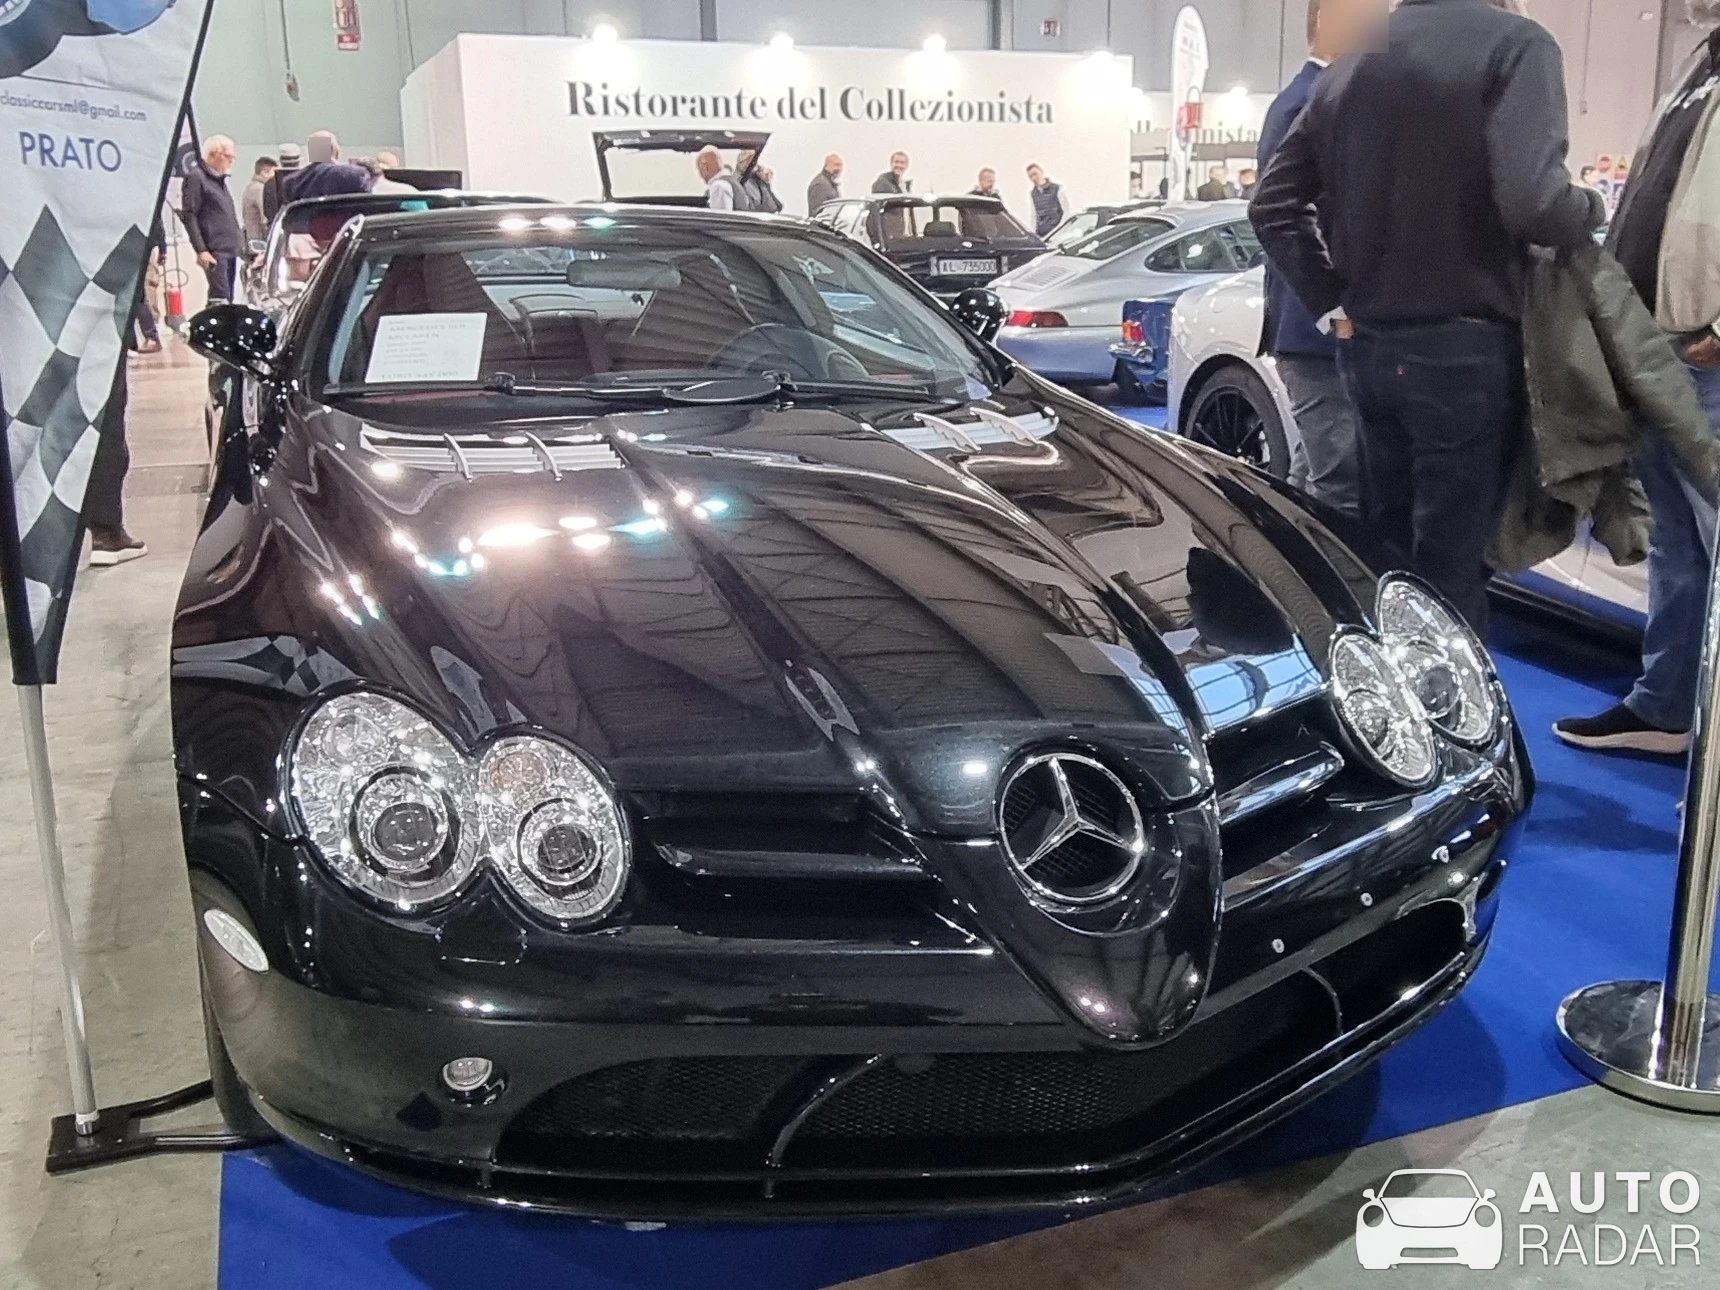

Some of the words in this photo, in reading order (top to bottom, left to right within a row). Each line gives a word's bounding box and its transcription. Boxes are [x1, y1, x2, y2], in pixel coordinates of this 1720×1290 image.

[566, 80, 769, 119] Ristorante
[777, 87, 827, 119] del
[839, 87, 1053, 123] Collezionista
[18, 131, 122, 172] PRATO
